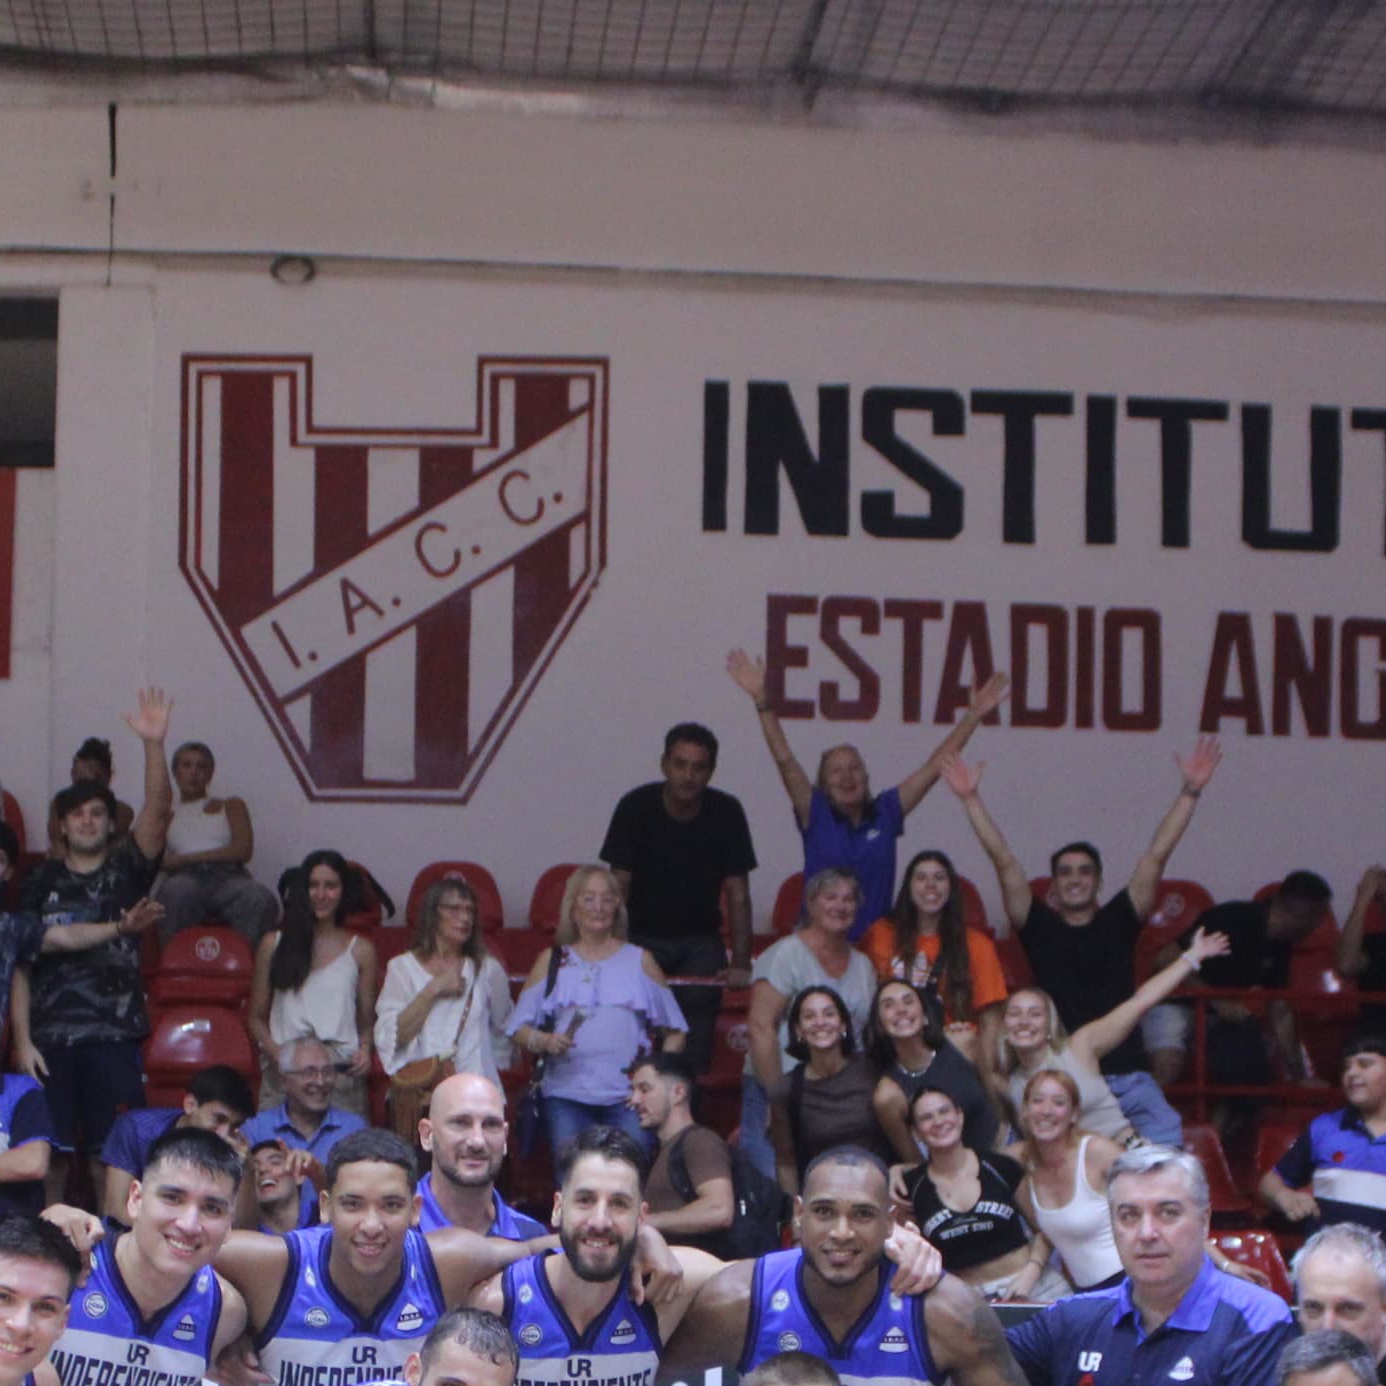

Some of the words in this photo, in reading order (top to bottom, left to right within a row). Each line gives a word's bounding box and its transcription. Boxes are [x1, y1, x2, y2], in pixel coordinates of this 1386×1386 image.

[763, 594, 1162, 731] ESTADIO
[127, 1343, 150, 1366] UR
[351, 1345, 378, 1366] UR
[1077, 1350, 1103, 1373] UR
[566, 1357, 592, 1379] UR
